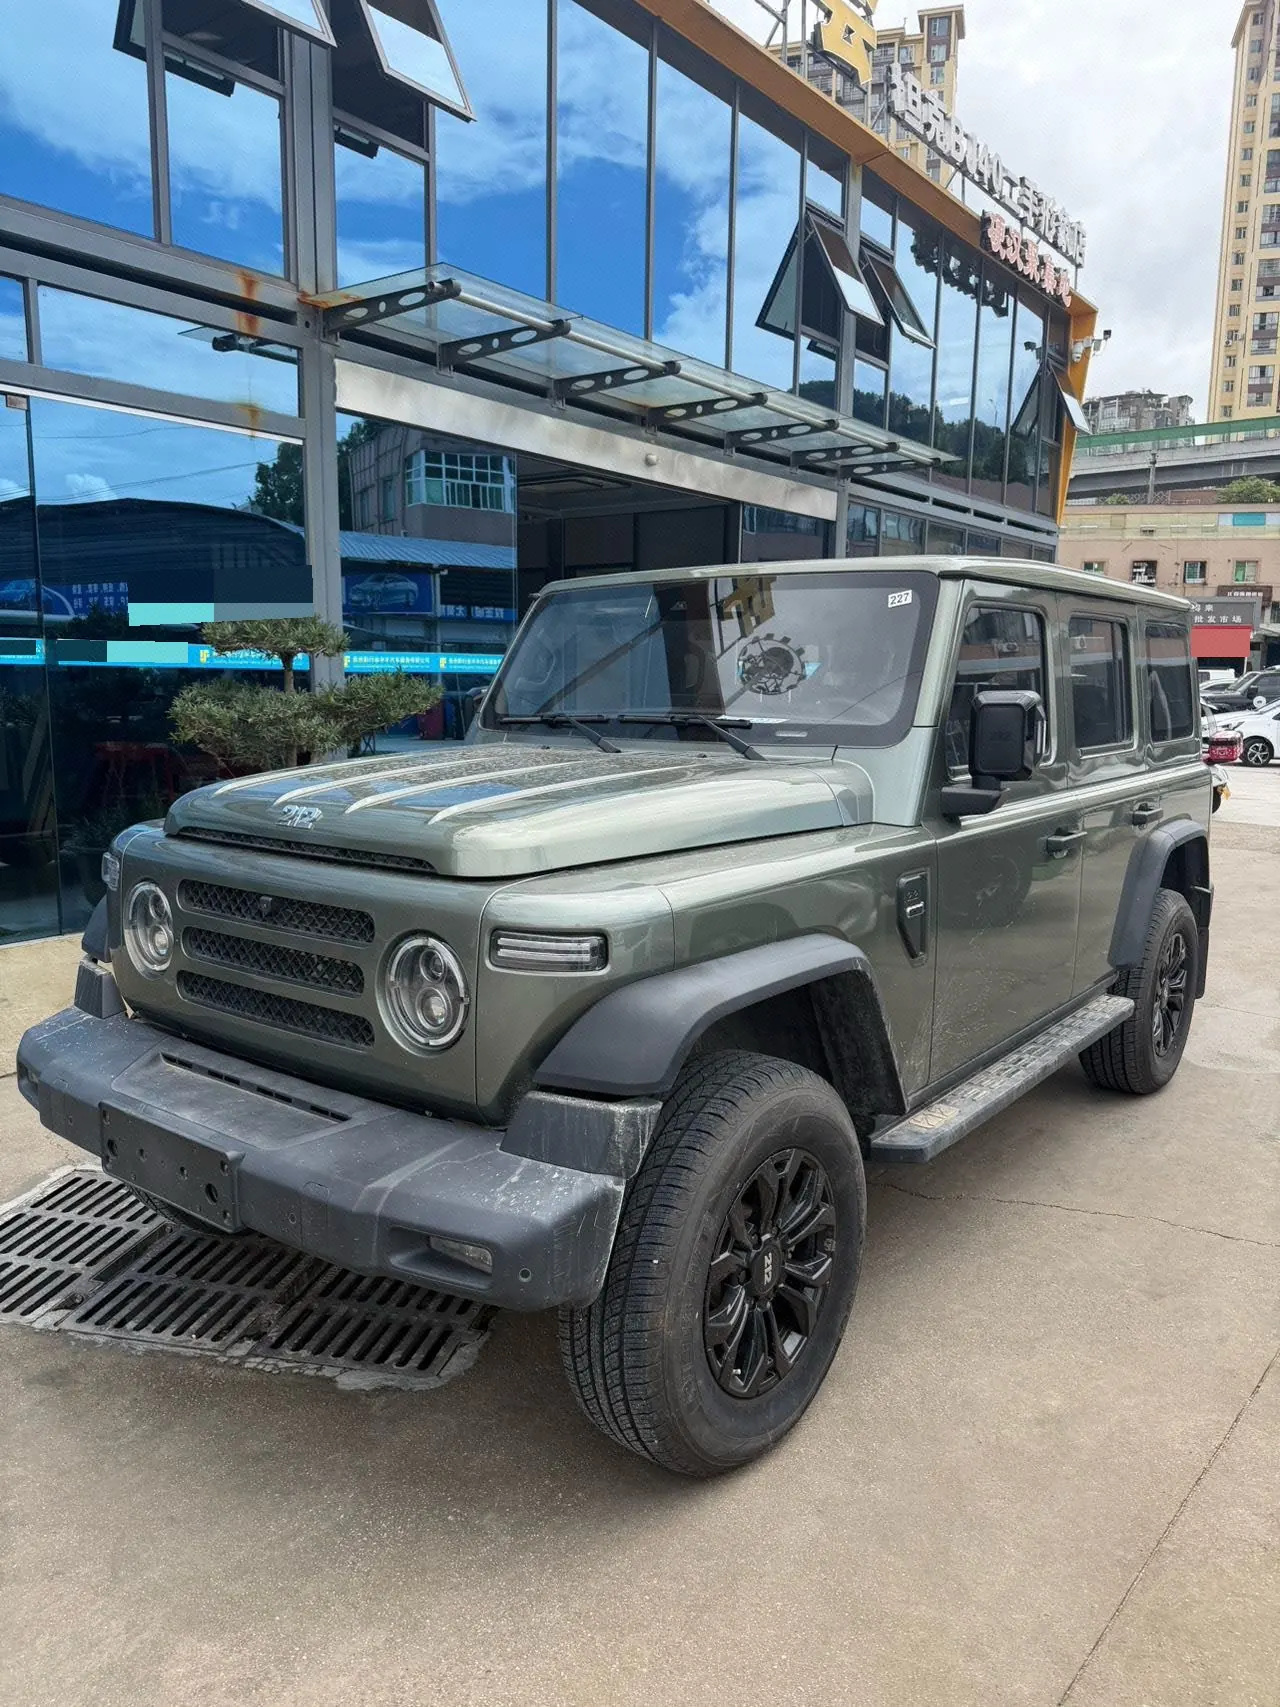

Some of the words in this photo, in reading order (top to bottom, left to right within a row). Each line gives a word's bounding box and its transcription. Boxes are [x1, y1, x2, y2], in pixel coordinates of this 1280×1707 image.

[890, 592, 910, 605] 227
[1194, 615, 1242, 624] 批发市场
